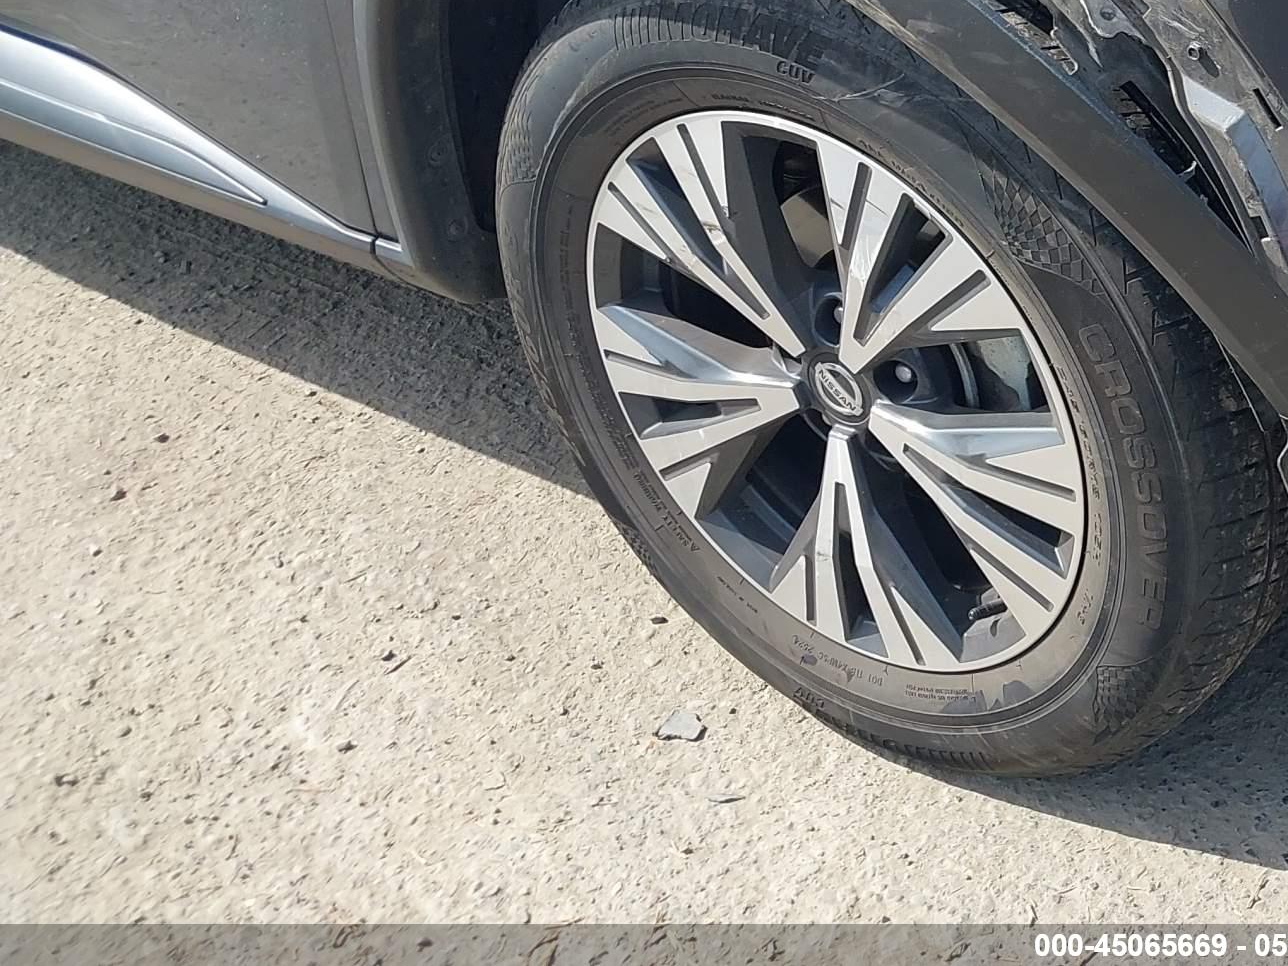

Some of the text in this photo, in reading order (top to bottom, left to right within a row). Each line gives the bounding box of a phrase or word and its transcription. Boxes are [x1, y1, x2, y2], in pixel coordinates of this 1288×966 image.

[776, 60, 815, 84] CUV
[818, 369, 857, 412] NISSAN
[1078, 323, 1169, 630] CROSSOVER
